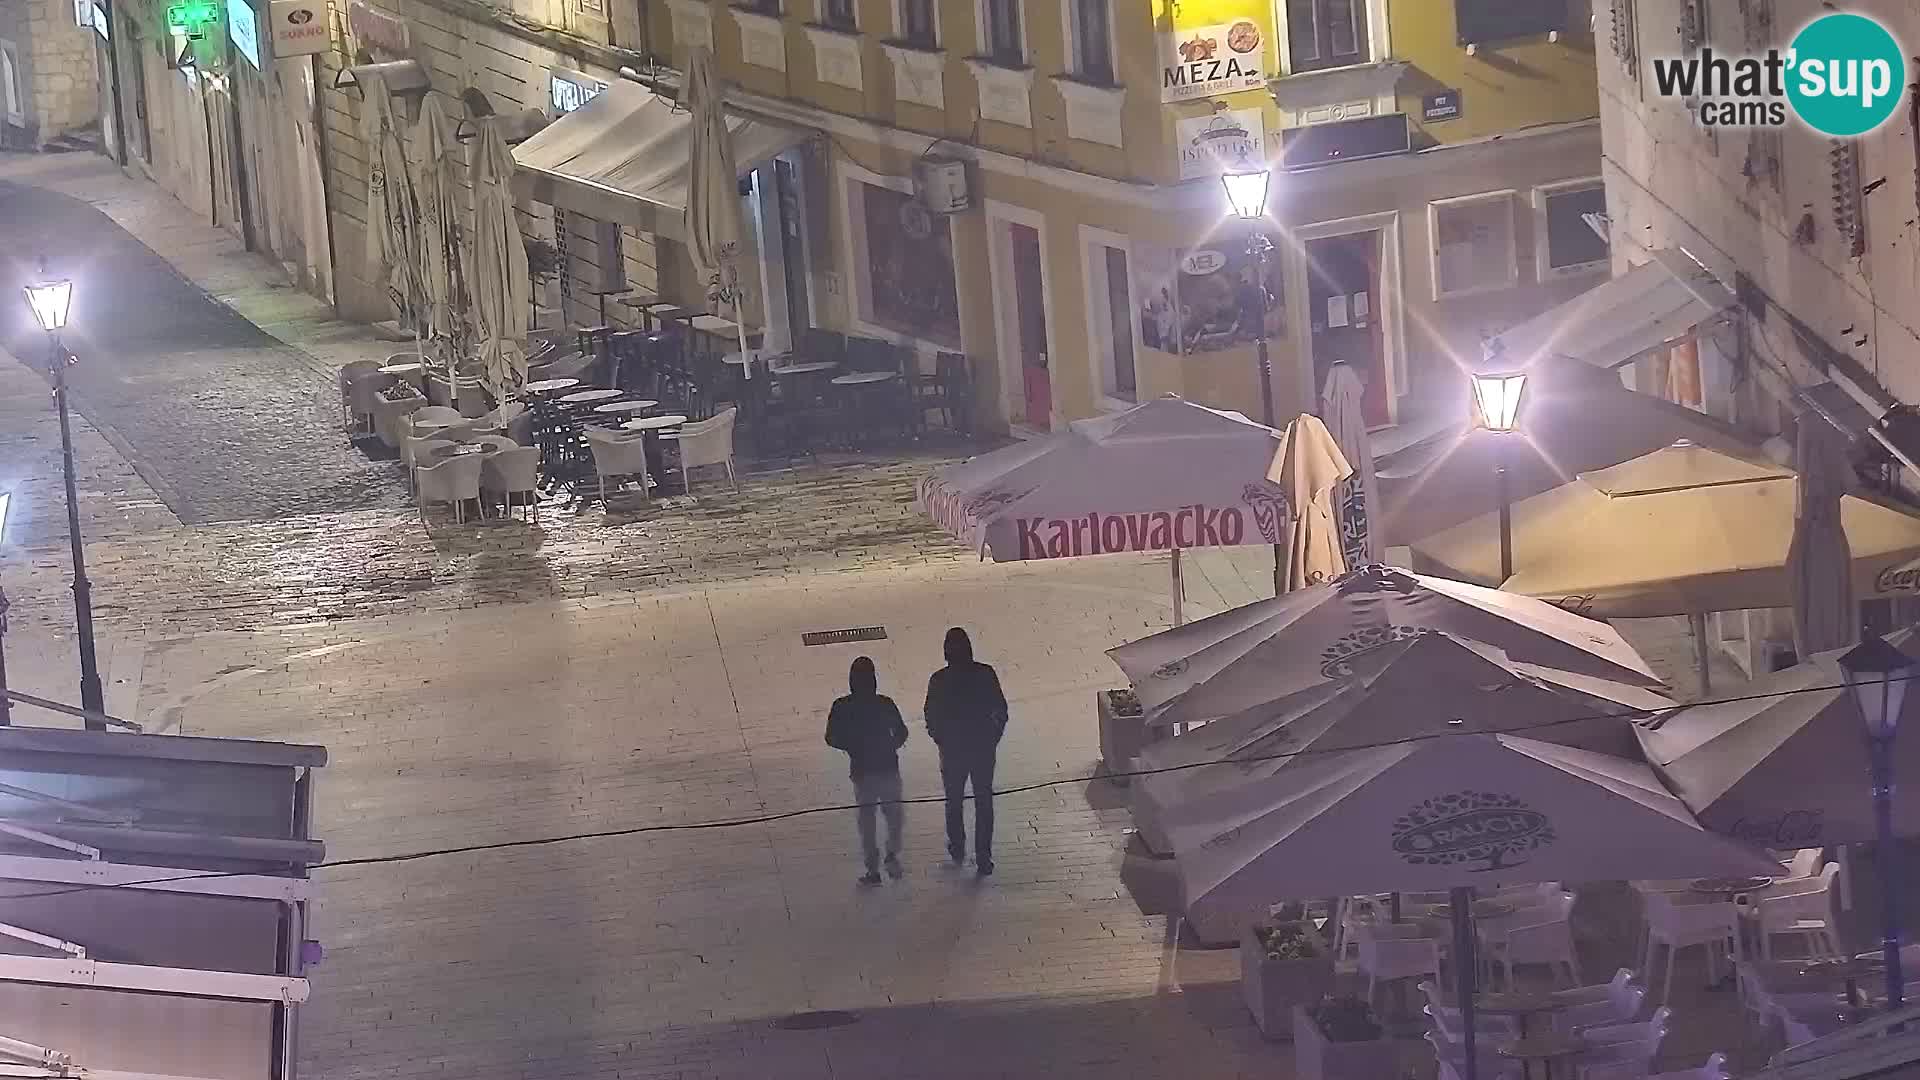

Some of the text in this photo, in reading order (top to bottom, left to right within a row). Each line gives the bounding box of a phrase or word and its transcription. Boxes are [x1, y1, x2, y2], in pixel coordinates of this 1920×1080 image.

[1164, 57, 1242, 88] MEZA
[1016, 503, 1244, 560] Karlovačko
[1430, 815, 1530, 847] RAUCH
